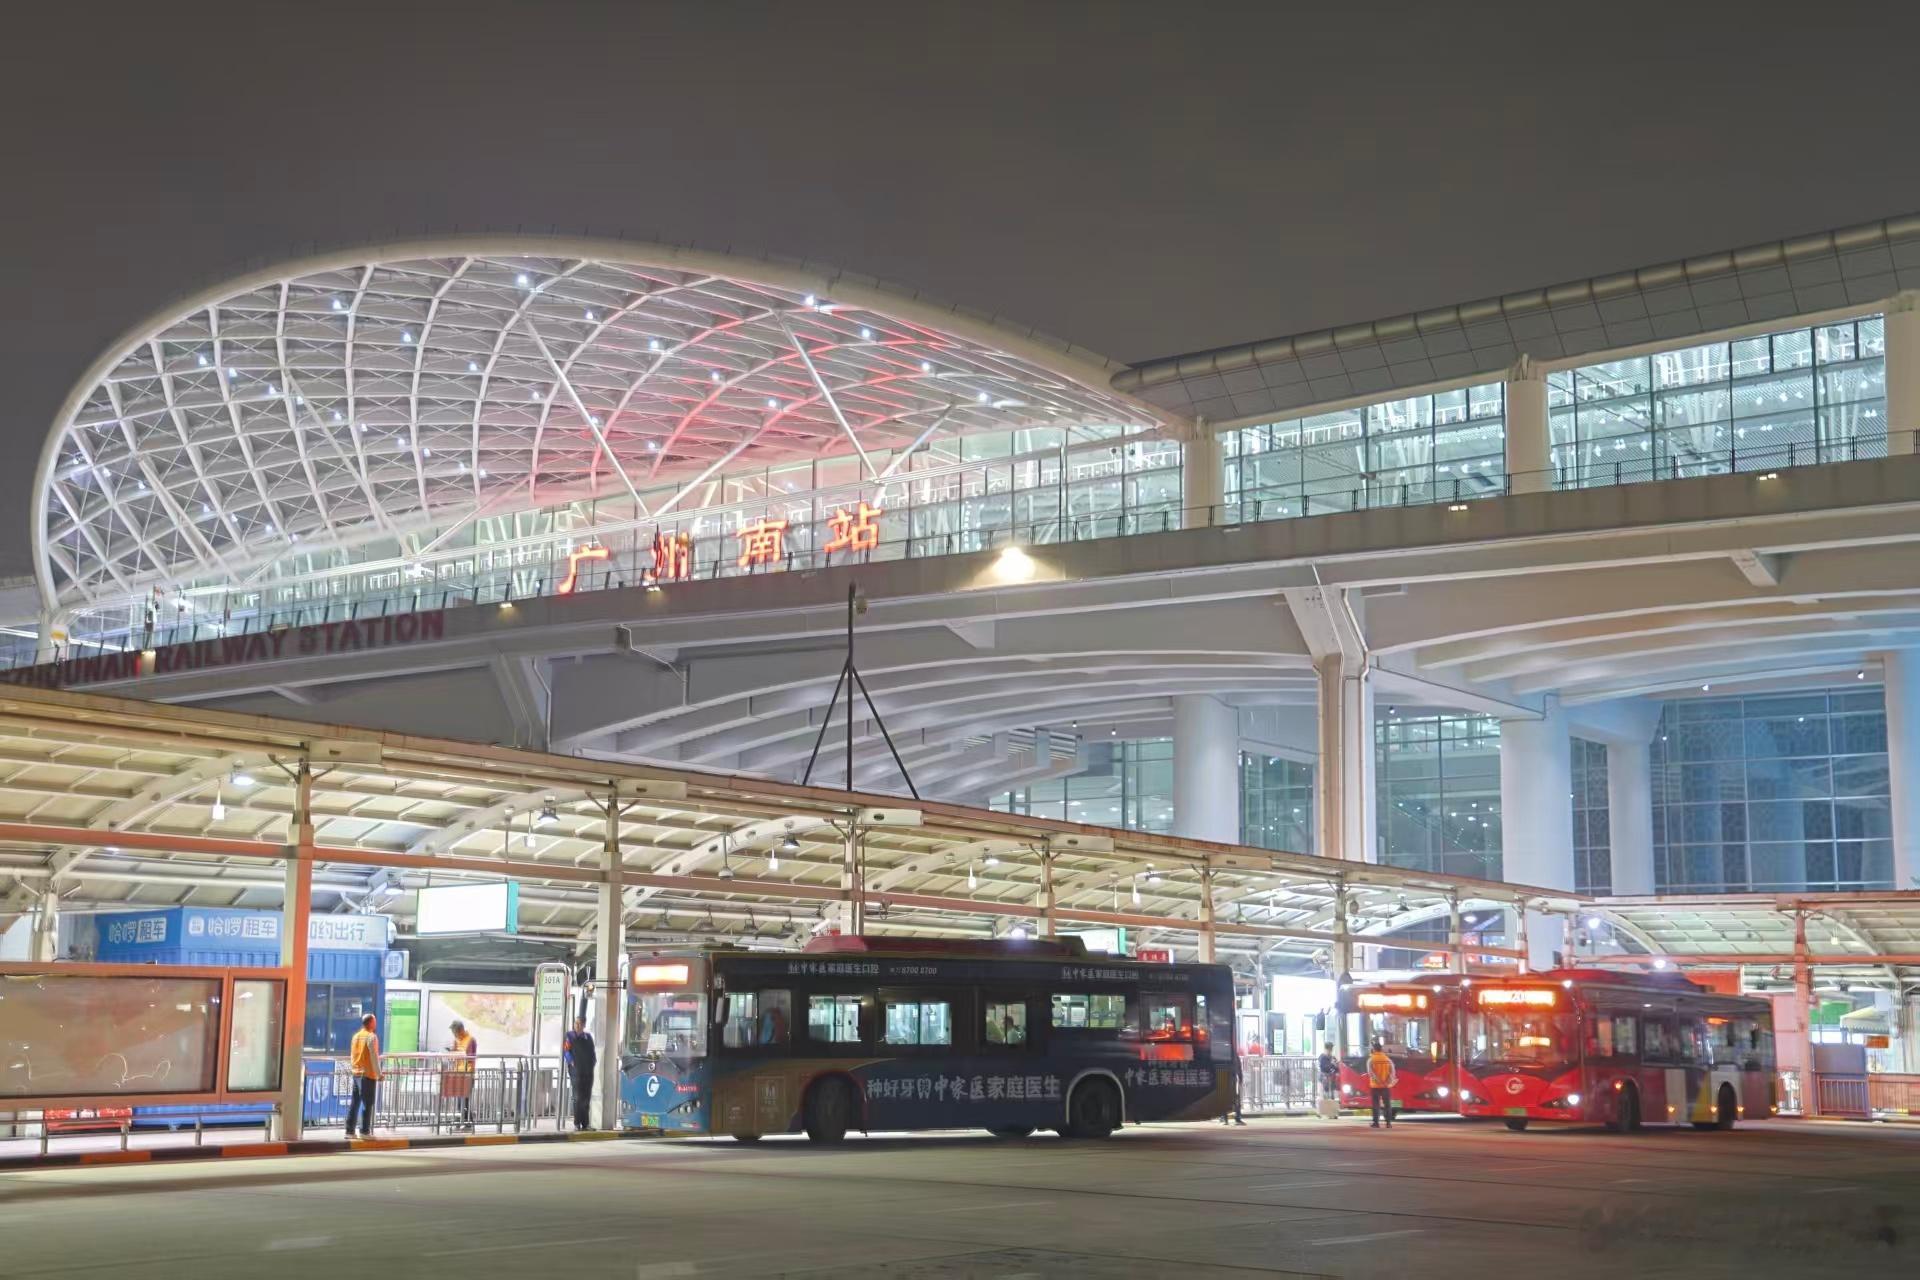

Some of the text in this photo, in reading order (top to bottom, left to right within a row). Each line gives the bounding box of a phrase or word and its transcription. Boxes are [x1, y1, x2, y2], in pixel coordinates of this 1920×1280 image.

[558, 502, 882, 595] 广州南站
[300, 610, 446, 654] STATION
[207, 916, 277, 938] 哈啰租车
